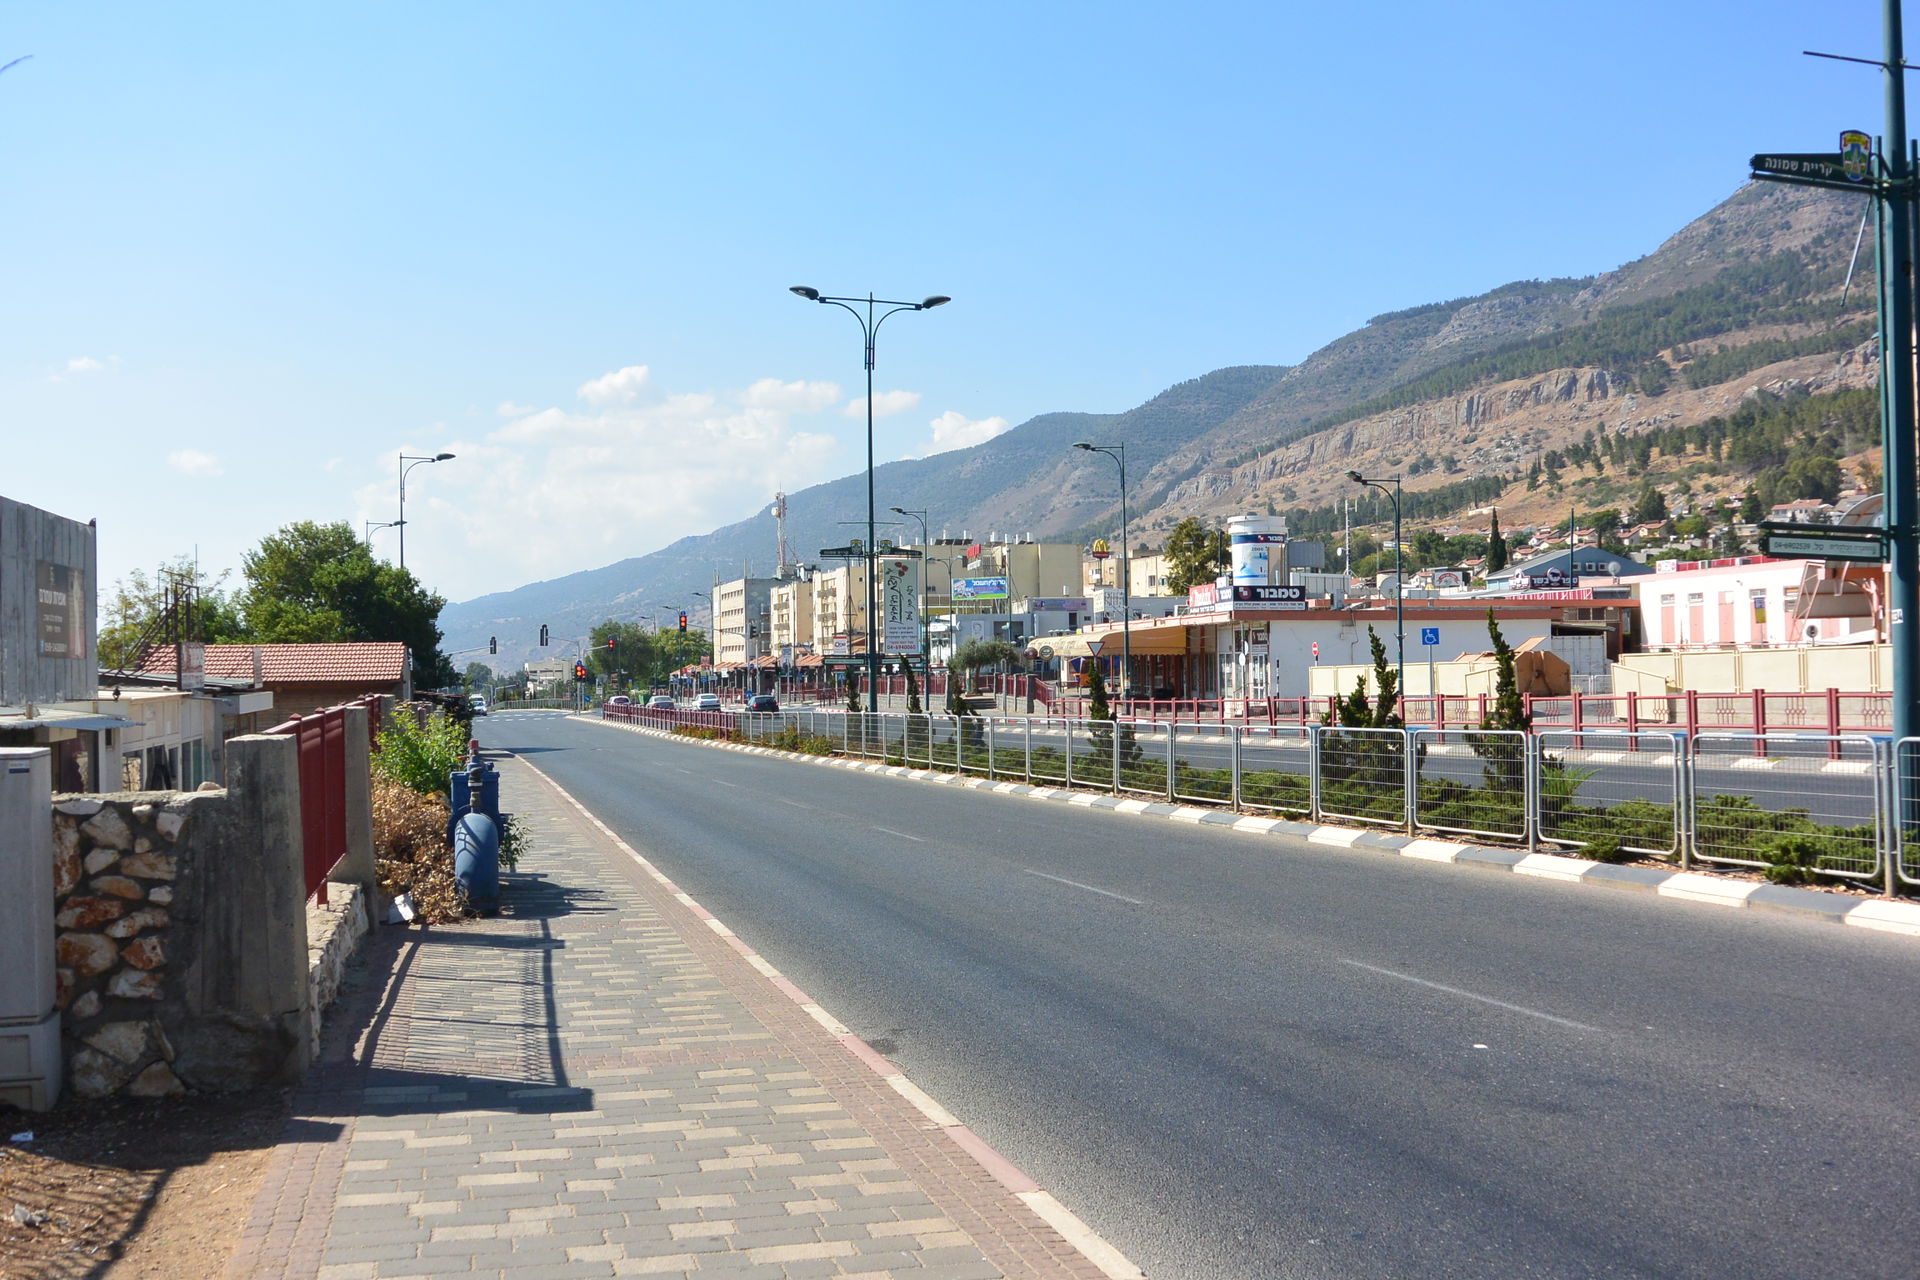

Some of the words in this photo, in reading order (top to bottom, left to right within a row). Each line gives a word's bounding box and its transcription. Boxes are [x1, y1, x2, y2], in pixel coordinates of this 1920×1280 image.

[1765, 157, 1799, 171] שמונה
[1802, 161, 1833, 176] קריית
[1257, 588, 1300, 599] טמבור
